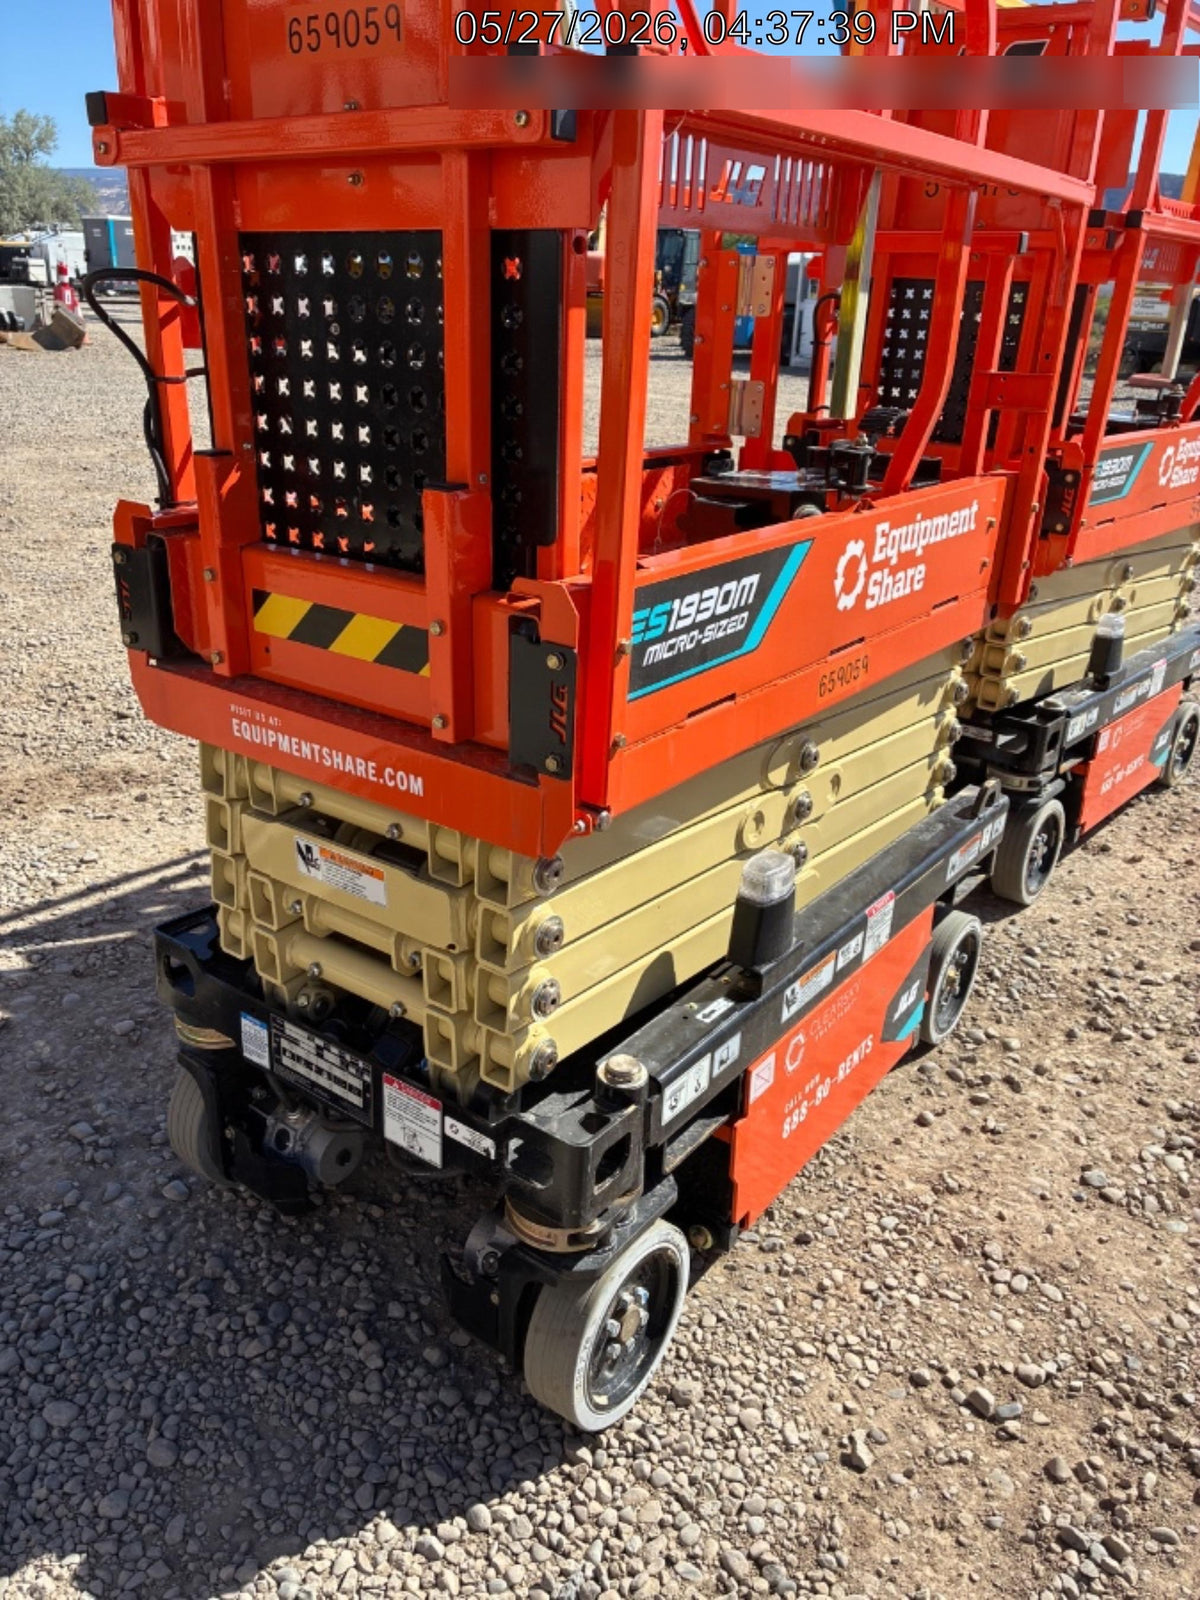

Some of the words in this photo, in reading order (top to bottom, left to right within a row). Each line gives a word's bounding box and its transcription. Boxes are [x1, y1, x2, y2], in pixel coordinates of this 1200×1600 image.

[288, 3, 402, 54] 659059
[871, 499, 979, 566] Equipment
[631, 572, 761, 645] ES1930M
[865, 562, 926, 611] Share
[642, 610, 749, 667] MICRO-SIZED
[818, 655, 869, 698] 659059
[551, 672, 568, 746] JLG
[231, 717, 424, 797] EQUIPMENTSHARE.COM
[892, 979, 921, 1023] JLG
[781, 1034, 874, 1139] 888-80-RENTS
